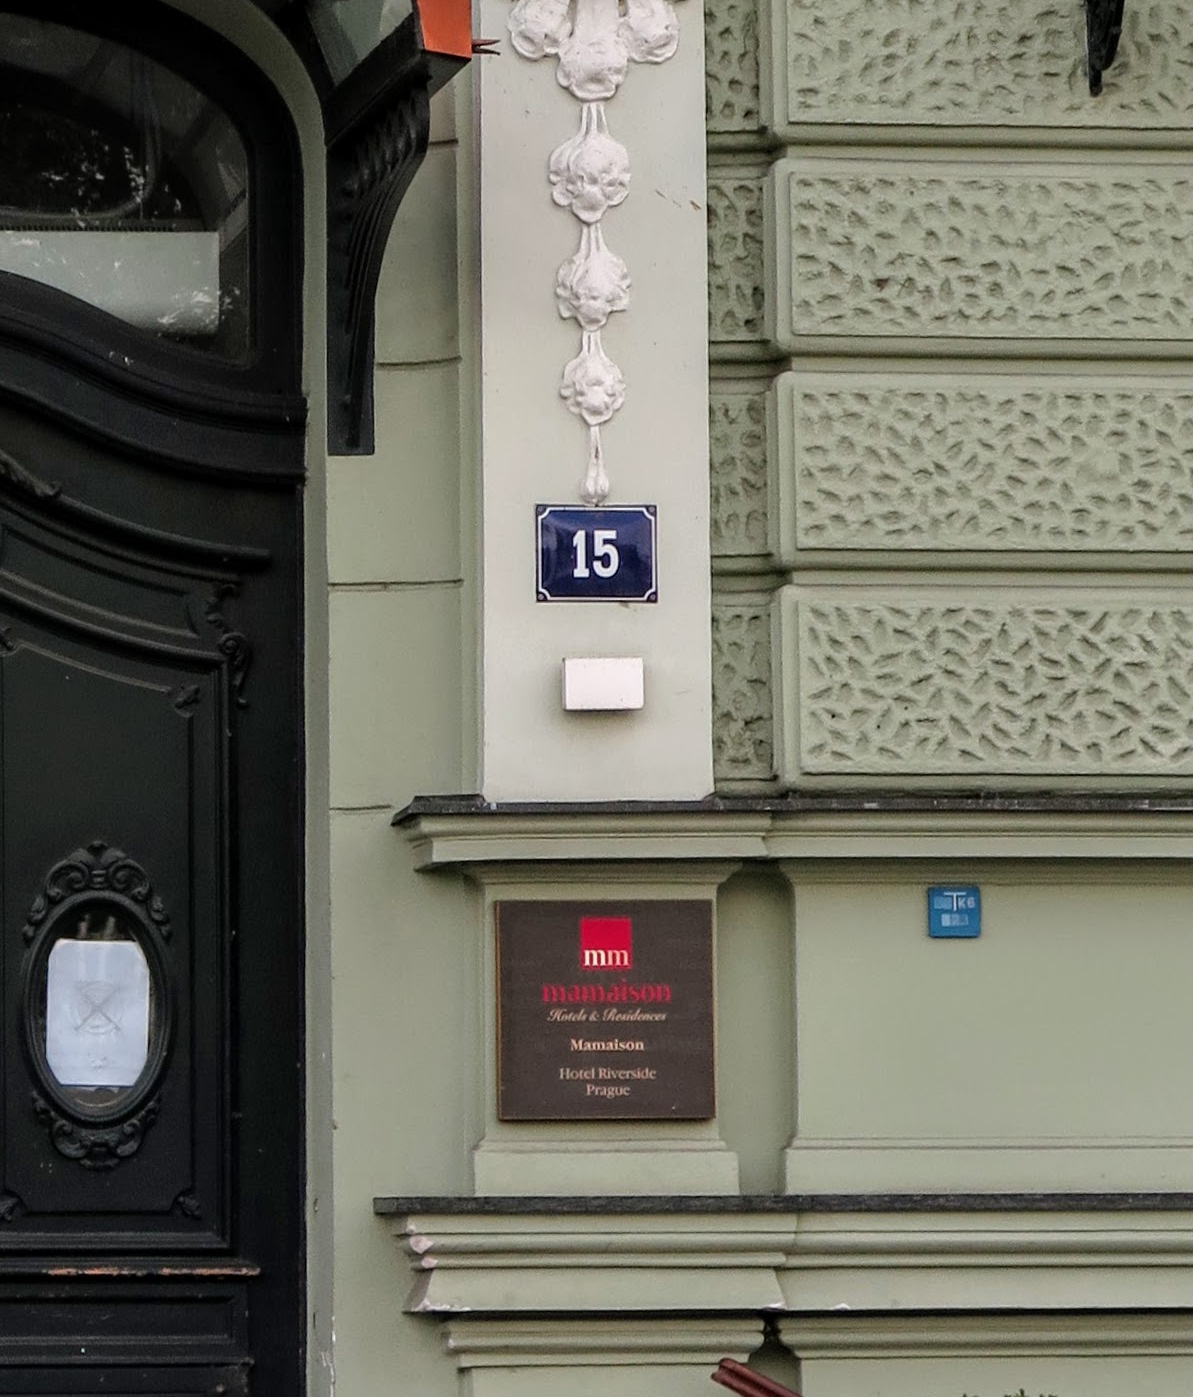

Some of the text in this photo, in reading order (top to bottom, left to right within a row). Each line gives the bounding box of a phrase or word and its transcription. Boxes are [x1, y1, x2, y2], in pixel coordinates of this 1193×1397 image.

[572, 529, 620, 578] 15
[583, 948, 629, 966] mm
[541, 978, 672, 1004] mamaison
[546, 1007, 667, 1022] Hotels & Residences
[570, 1038, 645, 1052] Mamaison
[559, 1067, 657, 1081] Hotel Riverside
[585, 1083, 631, 1099] Prague
